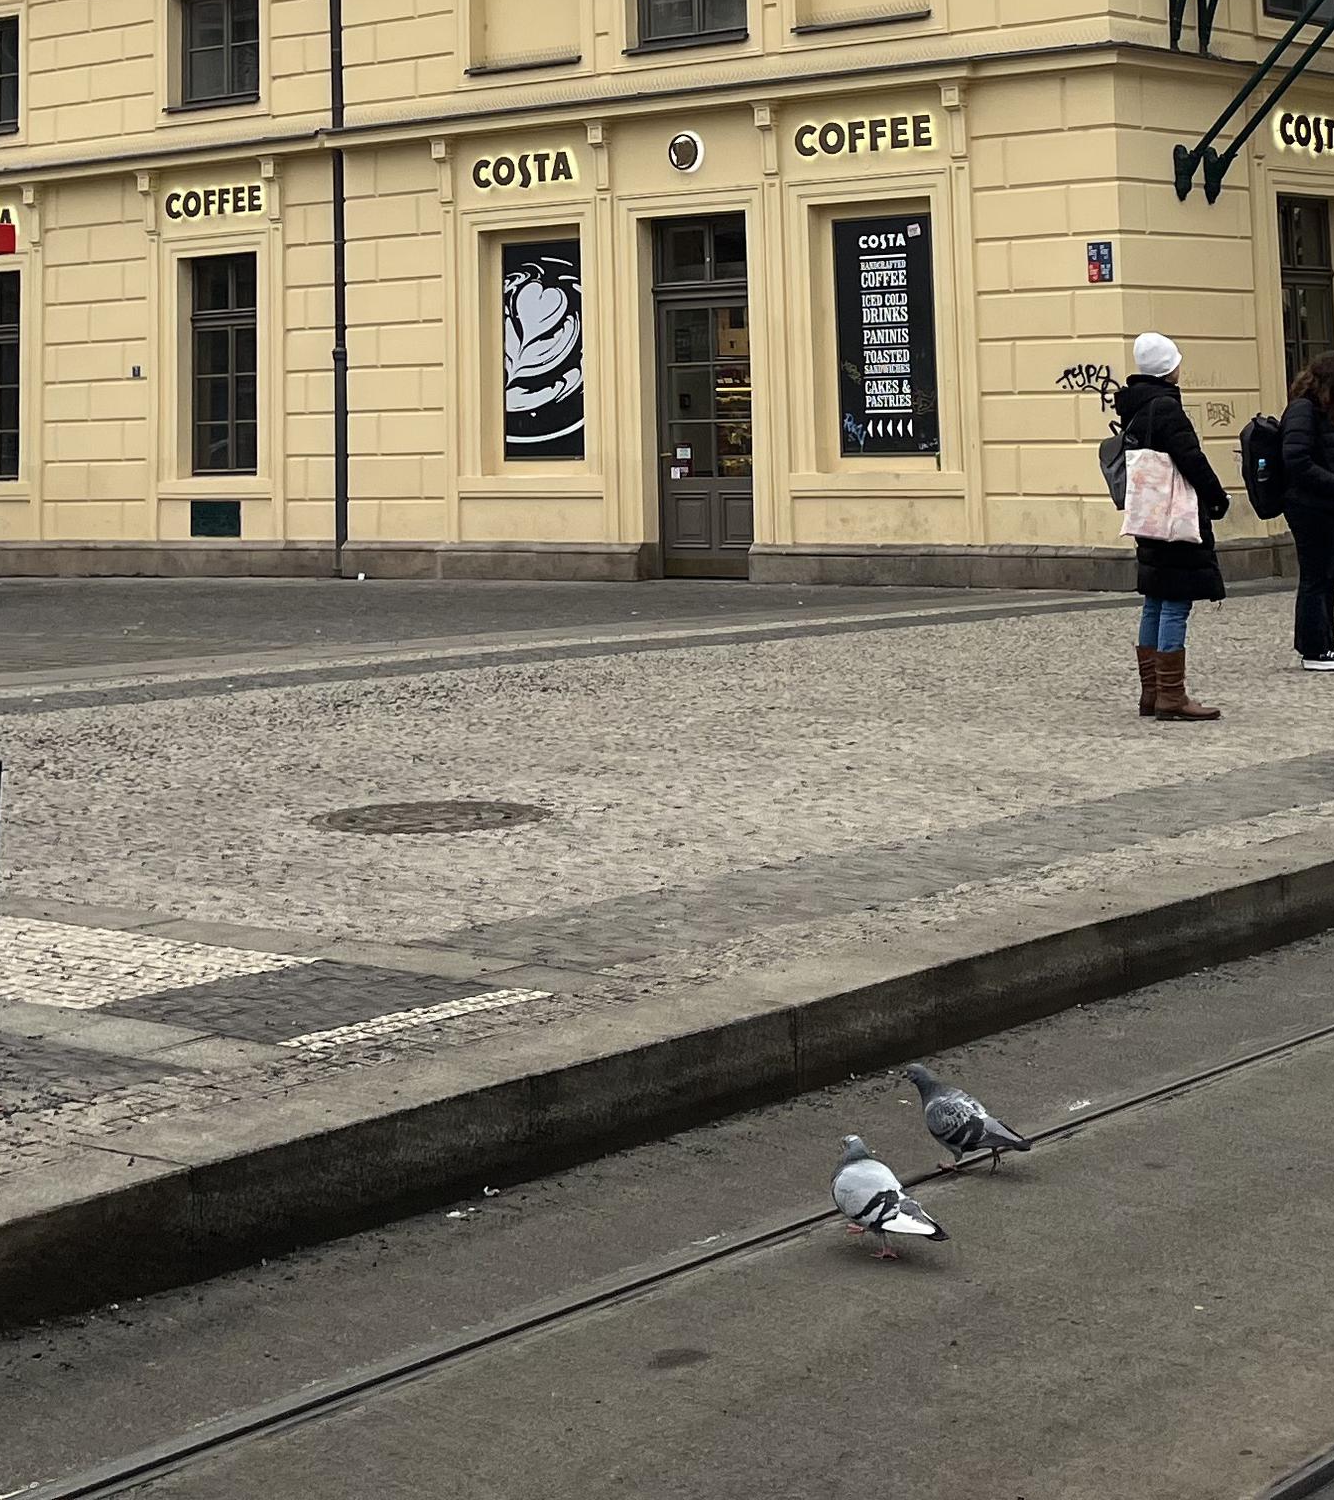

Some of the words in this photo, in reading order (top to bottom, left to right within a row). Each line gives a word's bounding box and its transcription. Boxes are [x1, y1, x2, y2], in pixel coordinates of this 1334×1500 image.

[794, 114, 933, 157] COFFEE
[473, 151, 573, 188] COSTA
[165, 185, 262, 220] COFFEE
[858, 233, 906, 250] COSTA
[860, 269, 907, 288] COFFEE
[862, 294, 882, 307] ICED
[884, 293, 907, 306] COLD
[862, 306, 908, 323] DRINKS
[863, 328, 909, 345] PANINIS
[863, 349, 910, 363] TOASTED
[865, 380, 899, 394] CAKES
[902, 380, 911, 393] &
[865, 394, 912, 407] PASTRIES
